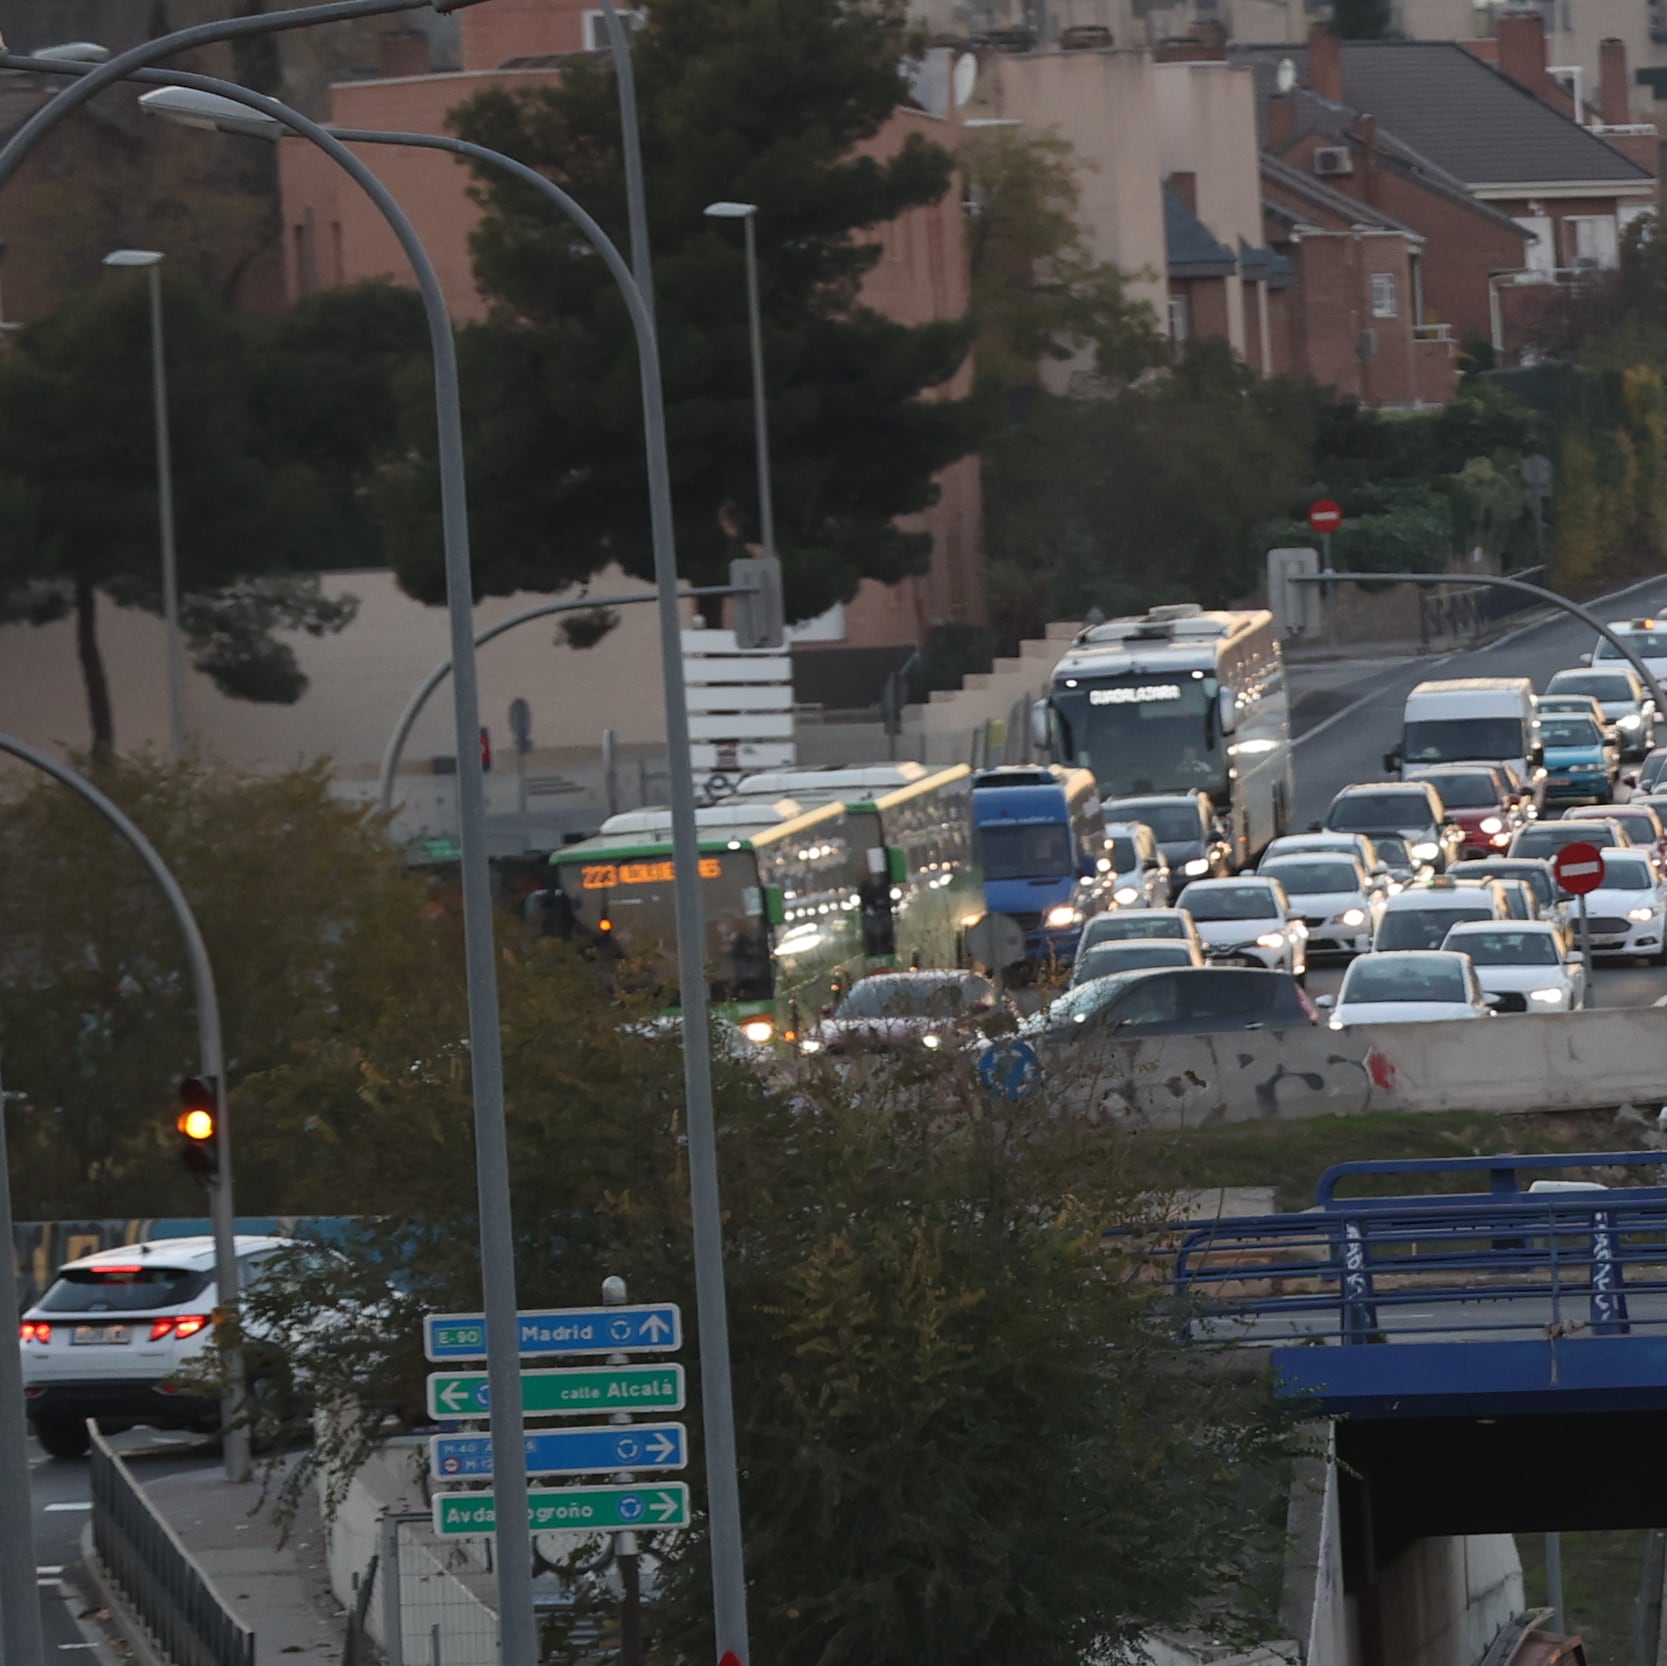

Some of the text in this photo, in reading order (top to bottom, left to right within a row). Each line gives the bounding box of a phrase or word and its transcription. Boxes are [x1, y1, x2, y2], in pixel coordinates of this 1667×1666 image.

[439, 1325, 593, 1345] E-90 Madrid
[560, 1378, 673, 1401] calle Alcalá
